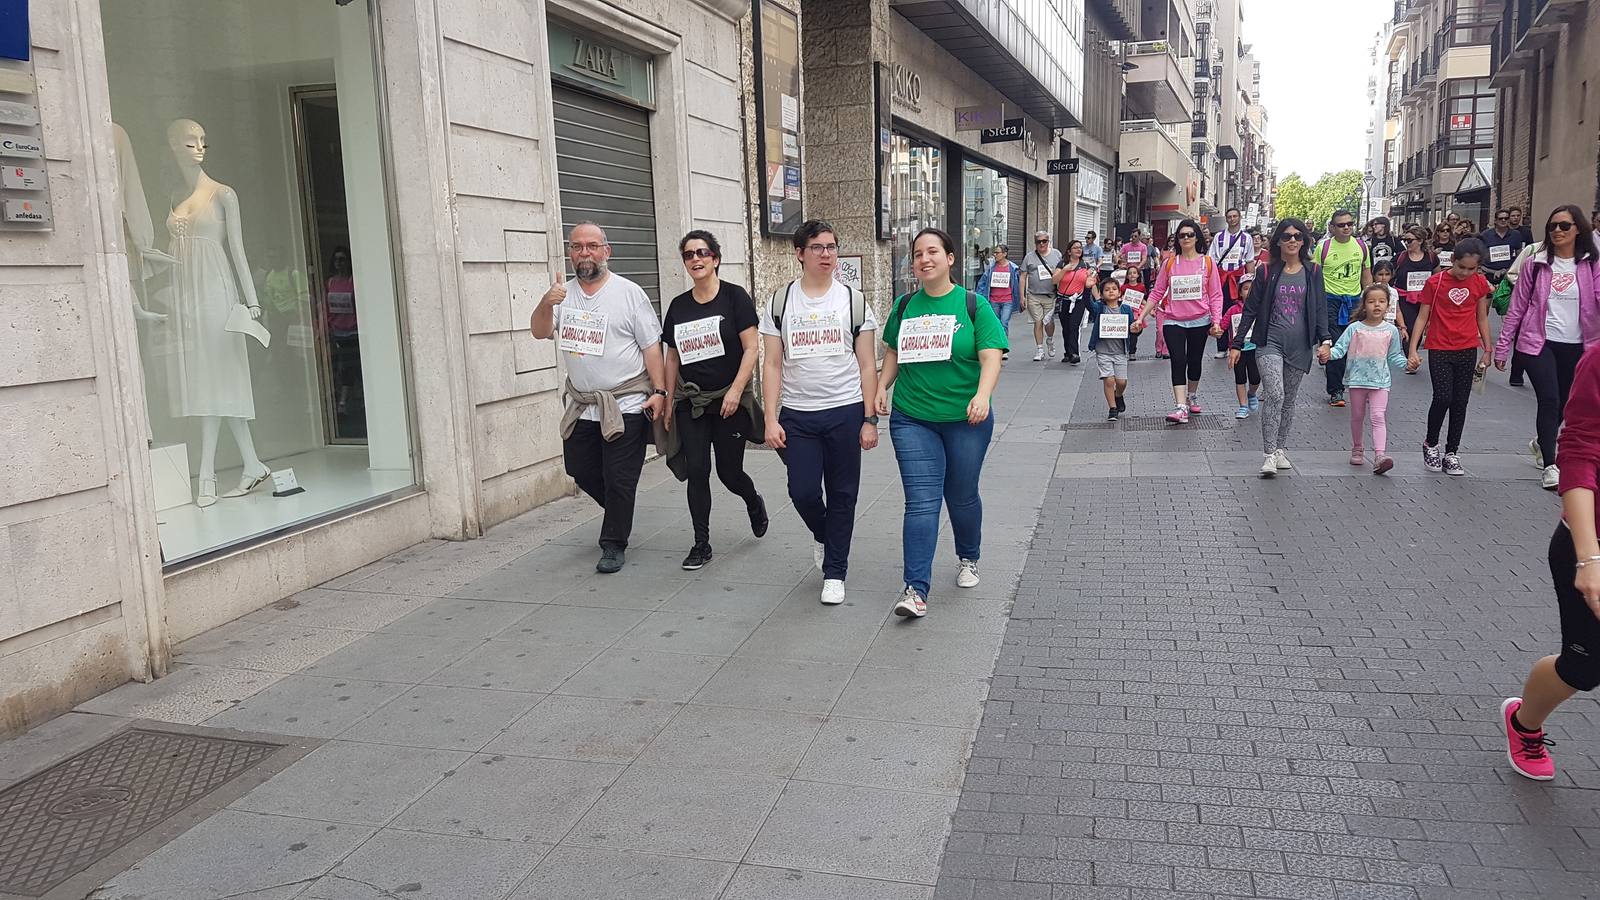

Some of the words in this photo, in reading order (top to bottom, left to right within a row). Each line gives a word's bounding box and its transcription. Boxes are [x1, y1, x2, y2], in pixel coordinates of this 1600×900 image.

[574, 37, 617, 80] ZARA
[893, 64, 922, 104] KIKO
[15, 143, 40, 151] EuroCasa
[15, 211, 42, 220] anfedasa
[791, 328, 842, 348] CARRASCAL-PRADA
[901, 334, 950, 352] CARRASCAL-PRADA
